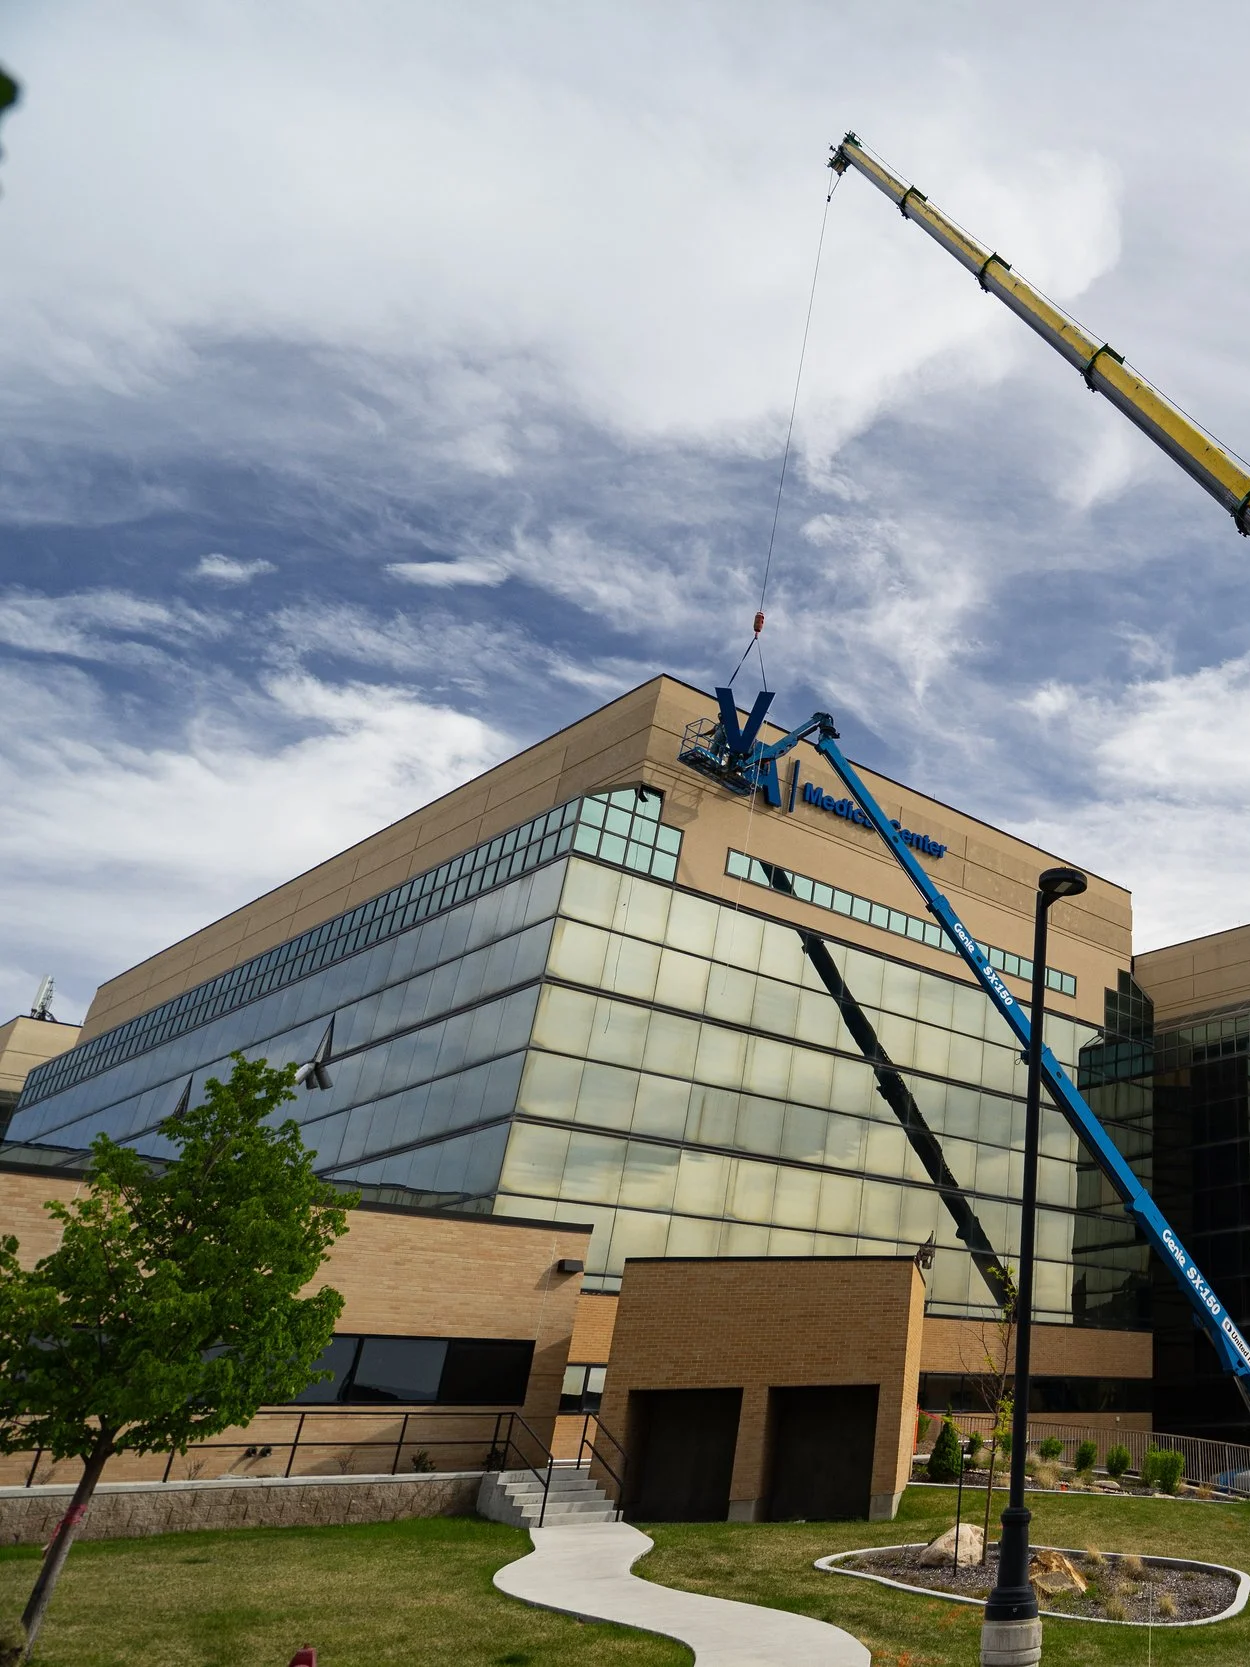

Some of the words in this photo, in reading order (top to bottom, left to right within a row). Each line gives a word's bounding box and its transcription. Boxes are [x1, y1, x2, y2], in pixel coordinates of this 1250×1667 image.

[803, 782, 875, 829] Medic
[954, 923, 975, 953] Genie
[983, 966, 1013, 1006] SX-150
[1162, 1229, 1186, 1268] Genie
[1186, 1267, 1221, 1315] SX-150
[1231, 1331, 1249, 1357] United
